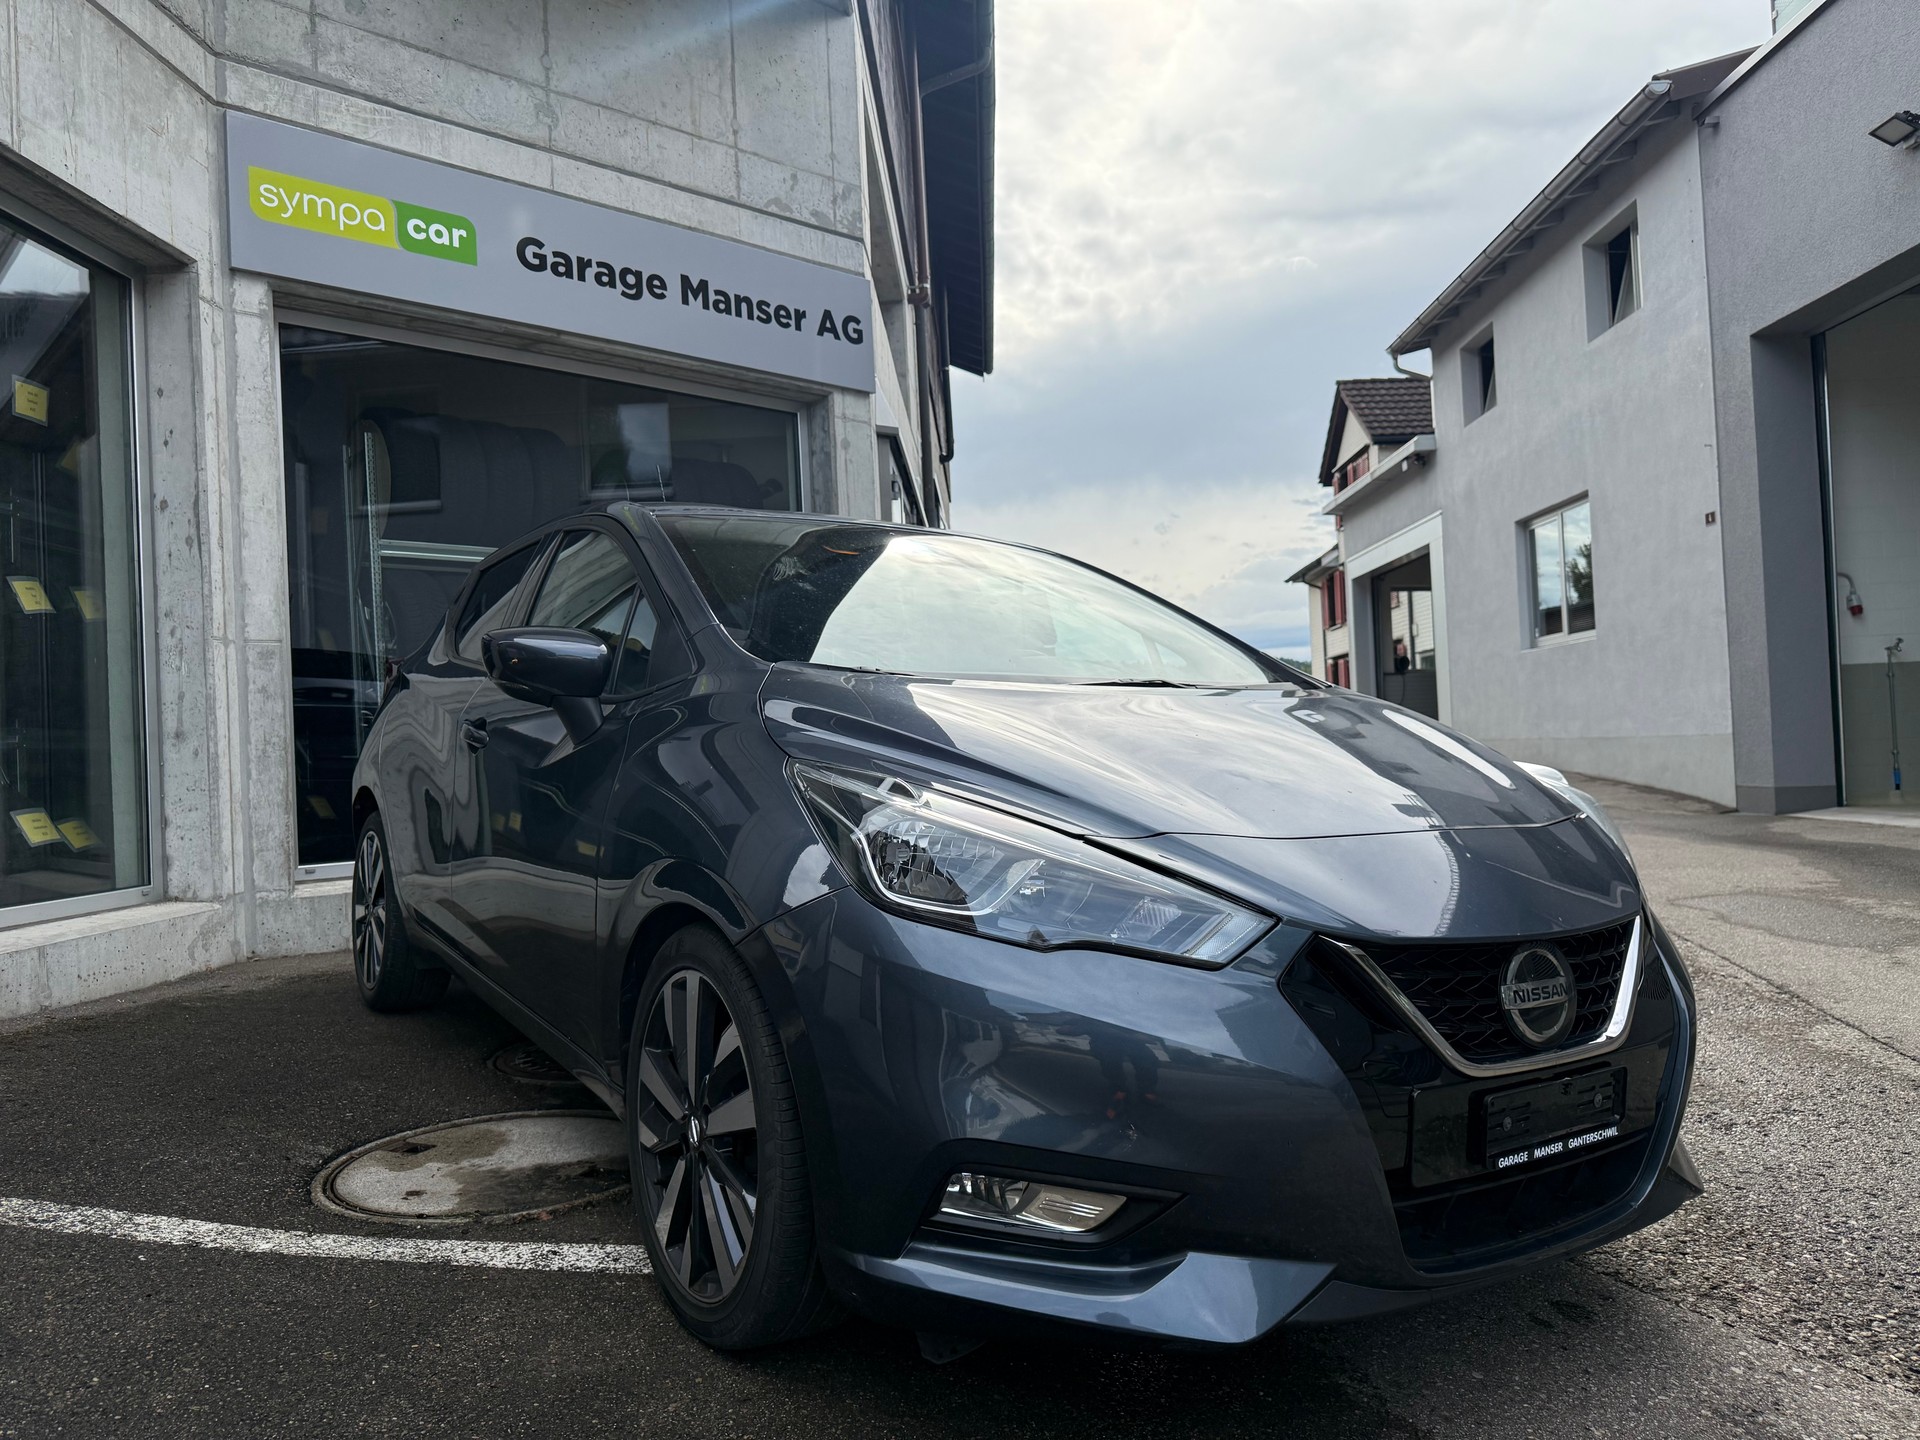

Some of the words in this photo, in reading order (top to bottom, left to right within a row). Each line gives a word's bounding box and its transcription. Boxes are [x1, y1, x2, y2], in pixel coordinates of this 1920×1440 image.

[259, 184, 385, 232] sympa
[407, 218, 467, 248] car
[516, 236, 667, 300] Garage
[680, 273, 806, 332] Manser
[816, 309, 864, 345] AG
[1512, 982, 1567, 1004] NISSAN
[1498, 1151, 1529, 1168] GARAGE
[1533, 1141, 1563, 1159] MANSER
[1568, 1126, 1618, 1149] GANTERSCHWIL
